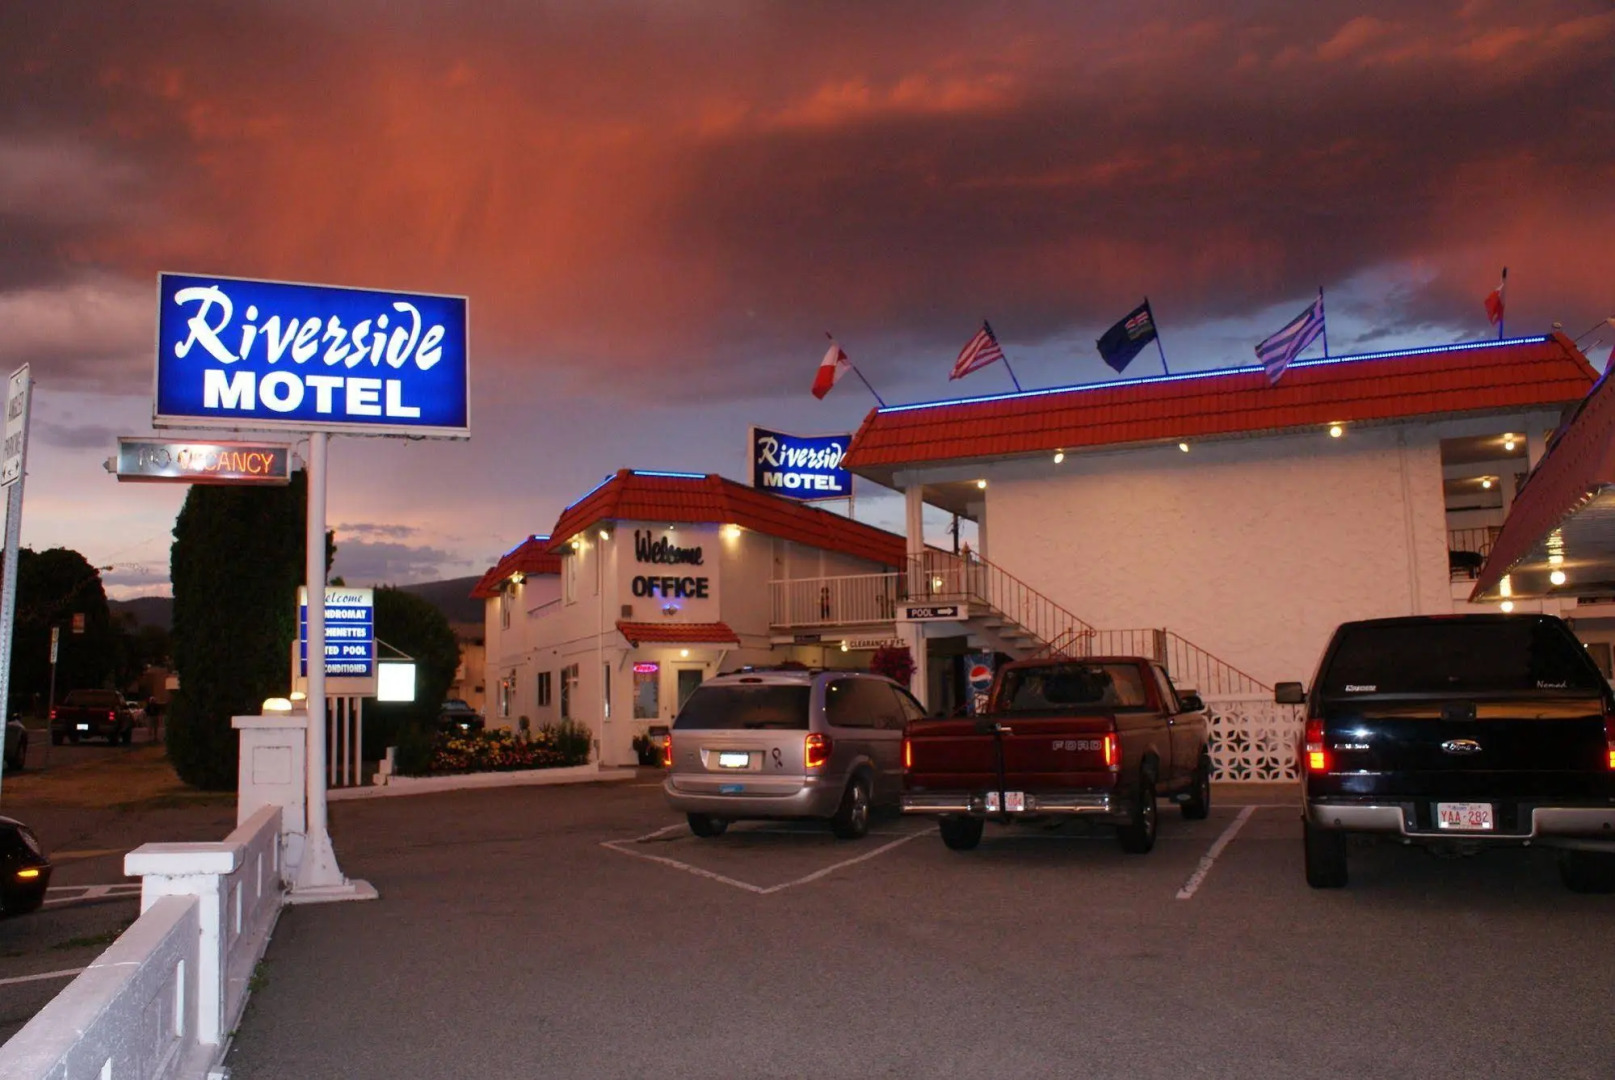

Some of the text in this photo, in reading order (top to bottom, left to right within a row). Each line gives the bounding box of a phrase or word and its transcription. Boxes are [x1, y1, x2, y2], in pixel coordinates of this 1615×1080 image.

[174, 285, 446, 370] Riverside
[203, 369, 421, 418] MOTEL
[178, 450, 274, 473] VCANCY
[763, 472, 842, 491] MOTEL
[634, 529, 705, 566] Welcome
[632, 576, 709, 598] OFFICE
[325, 592, 363, 603] elcome
[325, 609, 367, 619] NDROMAT
[911, 608, 934, 617] POOL
[850, 639, 888, 648] CLEARANCE
[325, 646, 366, 655] TED POOL
[1536, 680, 1568, 688] Nomad
[1052, 740, 1102, 751] FORD
